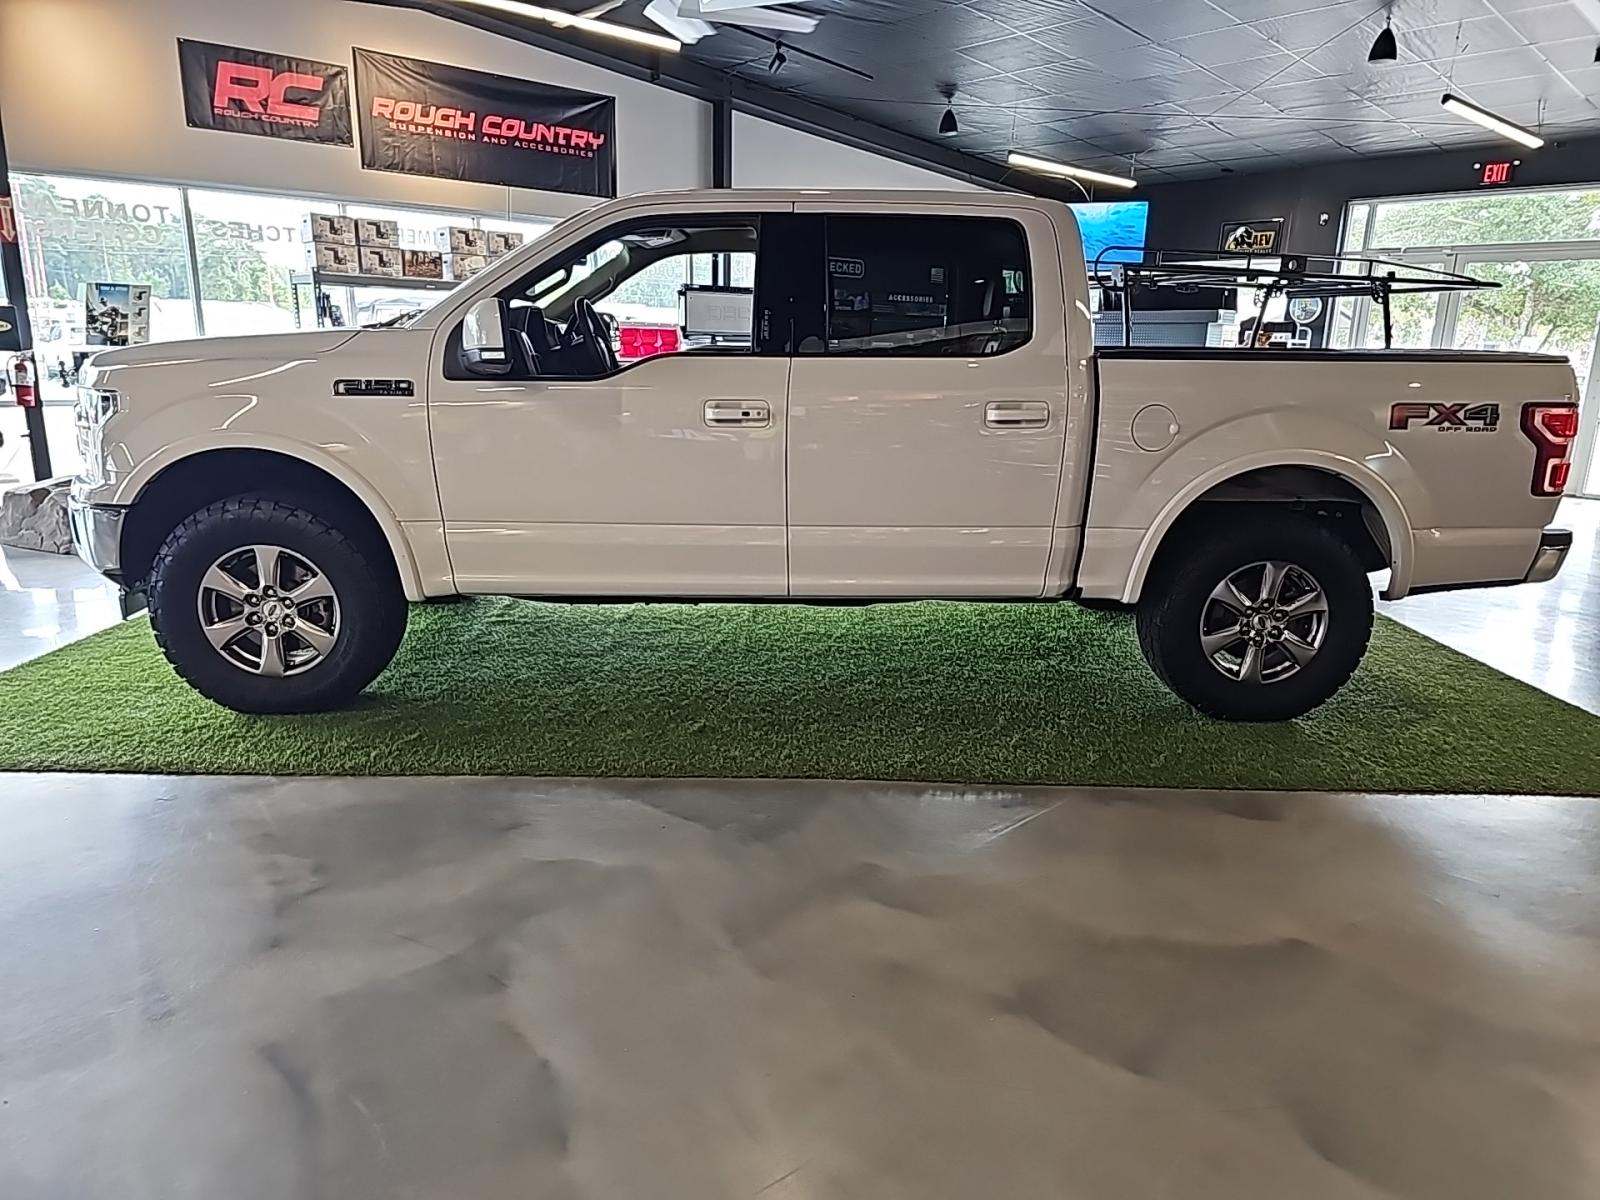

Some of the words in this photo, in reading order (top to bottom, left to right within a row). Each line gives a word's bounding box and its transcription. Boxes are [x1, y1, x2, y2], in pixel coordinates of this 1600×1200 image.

[214, 61, 324, 120] RC
[214, 108, 258, 119] ROUGH
[262, 114, 319, 128] COUNTRY
[372, 97, 475, 131] ROUGH
[482, 114, 604, 150] COUNTRY
[389, 121, 476, 141] SUSPENSION
[482, 136, 507, 146] AND
[514, 140, 593, 158] ACCESSORIES
[1483, 163, 1510, 182] EXIT
[1252, 233, 1272, 246] AEV
[829, 262, 862, 273] ECKED
[888, 294, 934, 303] ACCESSORIES
[1389, 403, 1499, 430] FX4
